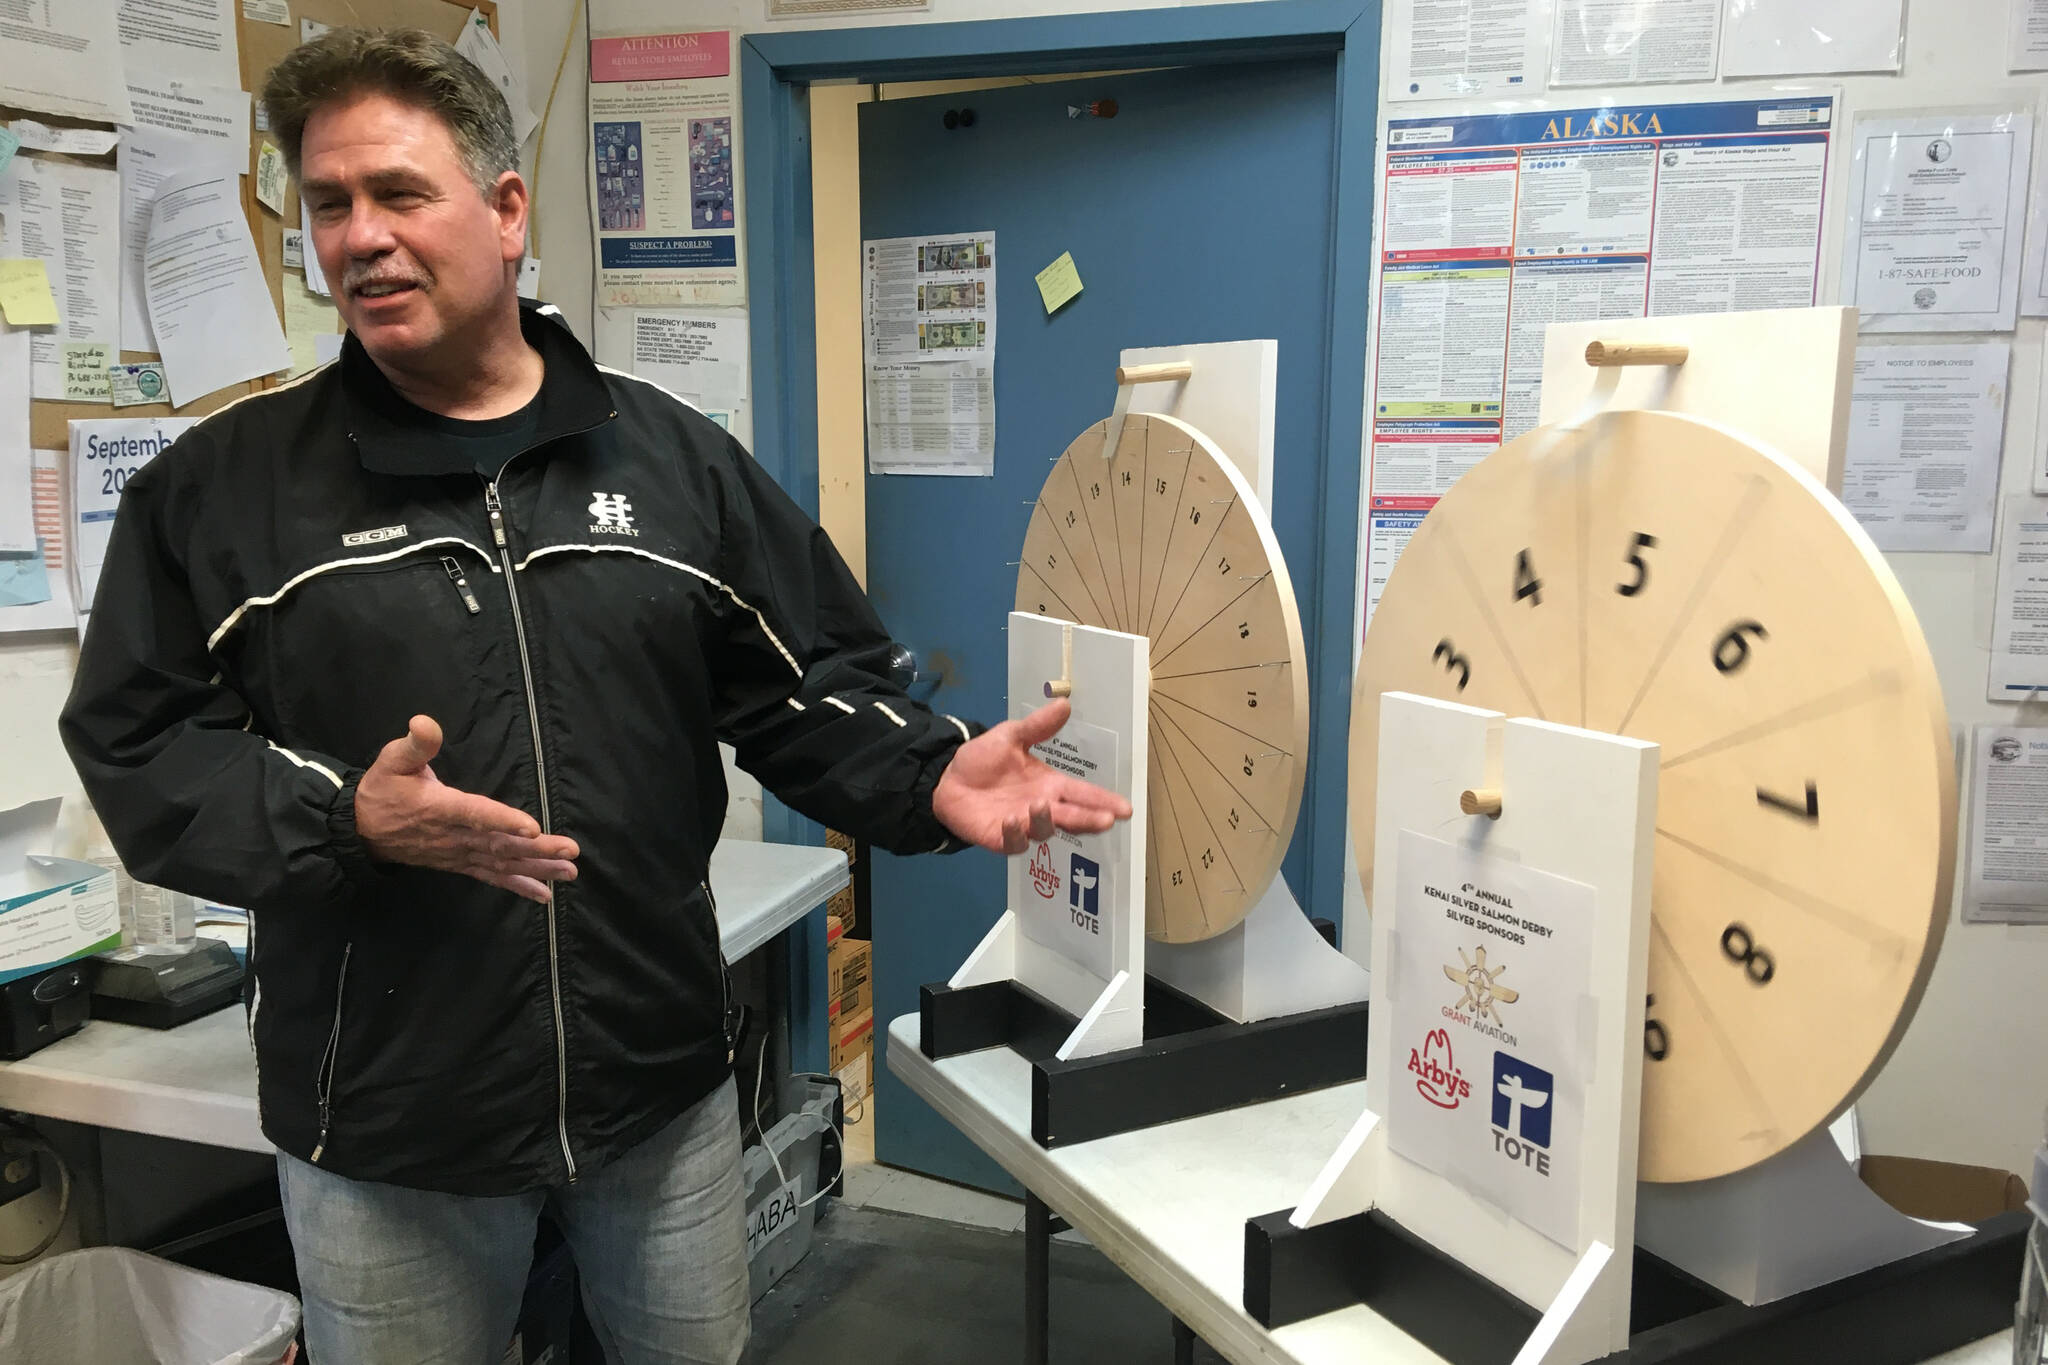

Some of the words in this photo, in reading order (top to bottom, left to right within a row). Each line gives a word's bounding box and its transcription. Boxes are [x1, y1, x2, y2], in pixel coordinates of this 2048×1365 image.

[622, 35, 699, 51] ATTENTION
[611, 55, 638, 65] RETAIL
[640, 54, 664, 65] STORE
[667, 52, 712, 63] EMPLOYEES
[1541, 112, 1663, 140] ALASKA
[629, 241, 664, 250] SUSPECT
[1879, 267, 1982, 279] 1-87-SAFE-FOOD
[637, 317, 680, 327] EMERGENCY
[682, 320, 717, 329] NUMBERS
[87, 430, 172, 465] Septemb
[102, 466, 138, 495] 20
[1121, 471, 1131, 487] 14
[1155, 478, 1167, 496] 15
[1090, 482, 1101, 500] 13
[1065, 510, 1077, 528] 12
[1189, 506, 1201, 525] 16
[345, 525, 407, 545] CCM
[588, 525, 640, 537] HOCKEY
[1047, 554, 1057, 569] 11
[1218, 557, 1232, 575] 17
[1614, 531, 1660, 599] 5
[1511, 546, 1544, 608] 4
[1238, 621, 1251, 639] 18
[1709, 617, 1771, 676] 6
[1431, 636, 1473, 693] 3
[1247, 690, 1257, 709] 19
[1060, 763, 1086, 778] SPONSORS
[1243, 753, 1255, 777] 20
[1755, 775, 1821, 827] 7
[1227, 807, 1240, 830] 21
[1201, 847, 1215, 870] 22
[1029, 859, 1061, 890] Arby's
[1171, 869, 1184, 887] 23
[1475, 889, 1513, 909] ANNUAL
[1070, 907, 1099, 935] TOTE
[1424, 885, 1450, 902] KENAI
[1451, 894, 1480, 913] SILVER
[1481, 905, 1520, 926] SALMON
[1521, 919, 1553, 938] DERBY
[1446, 908, 1475, 926] SILVER
[1476, 920, 1526, 945] SPONSORS
[1719, 919, 1776, 989] 8
[1441, 1006, 1472, 1027] GRANT
[1473, 1020, 1518, 1047] AVIATION
[1408, 1047, 1470, 1098] Arby's
[1491, 1128, 1550, 1177] TOTE
